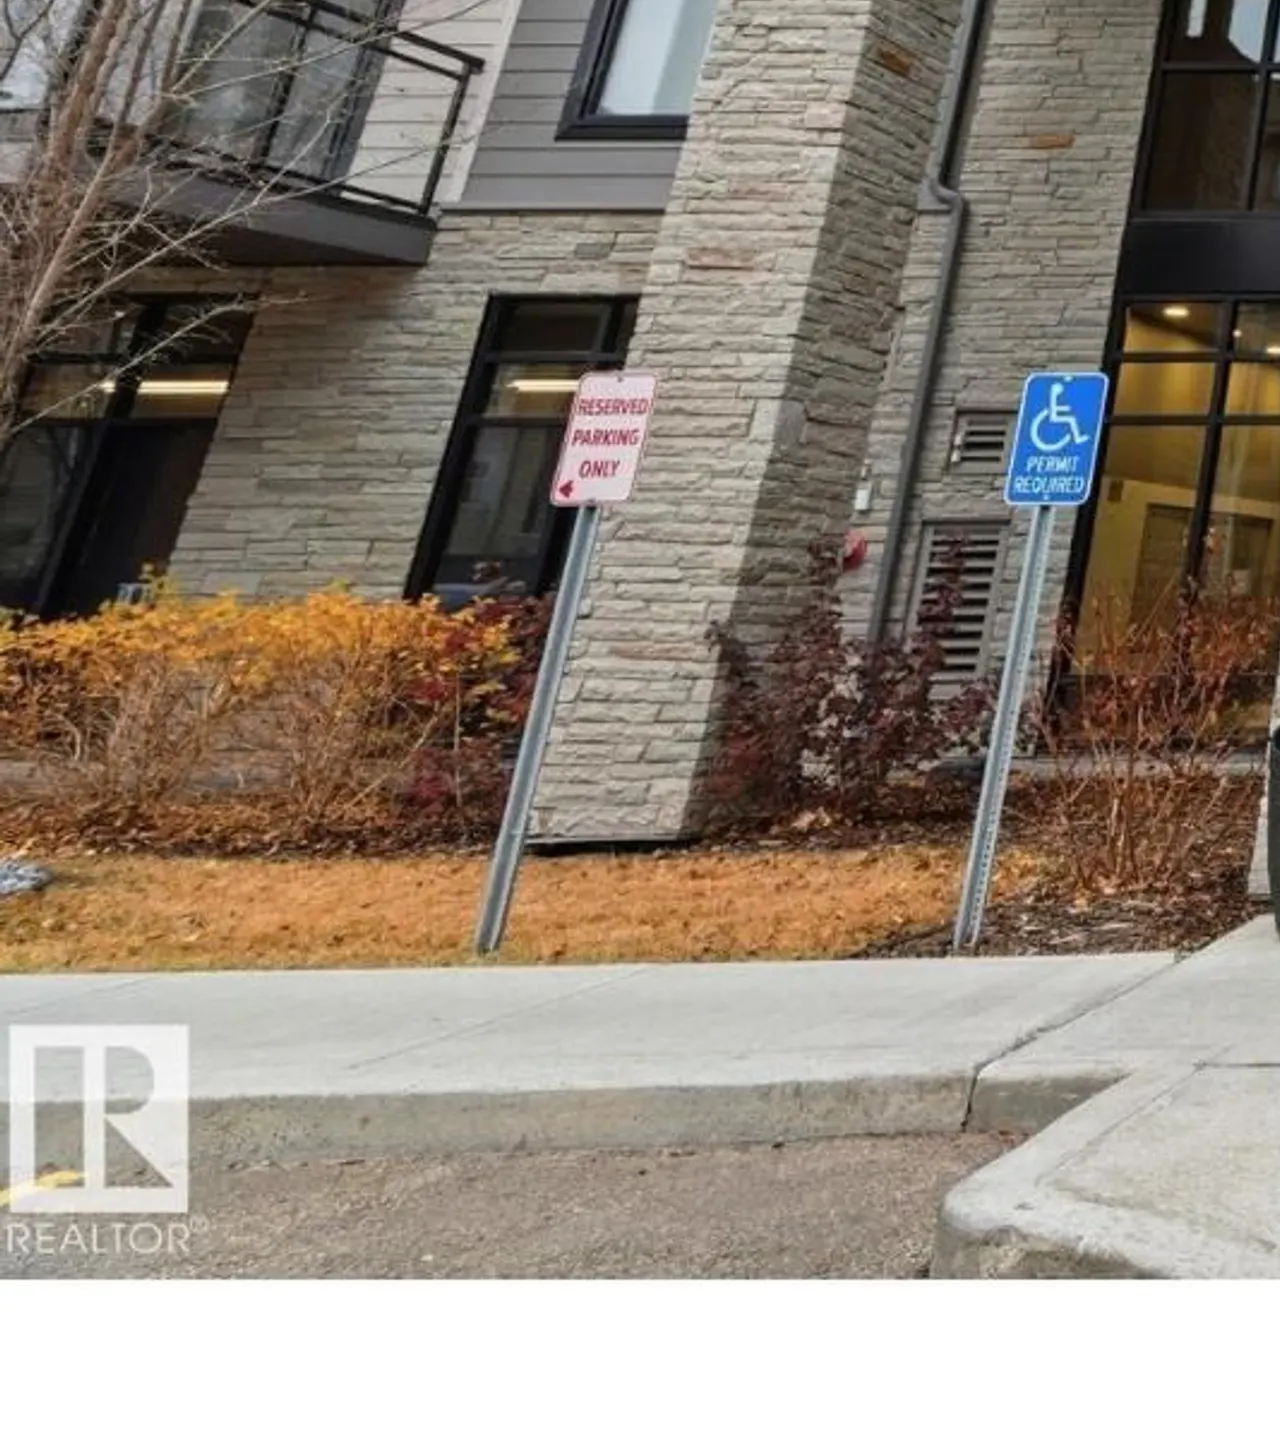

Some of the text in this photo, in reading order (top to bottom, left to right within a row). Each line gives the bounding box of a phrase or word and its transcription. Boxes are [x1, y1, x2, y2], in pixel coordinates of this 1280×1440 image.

[577, 398, 649, 416] RESERVED
[572, 429, 640, 446] PARKING
[578, 460, 620, 478] ONLY
[1026, 456, 1079, 472] PERMIT
[1013, 475, 1084, 493] REQUIRED
